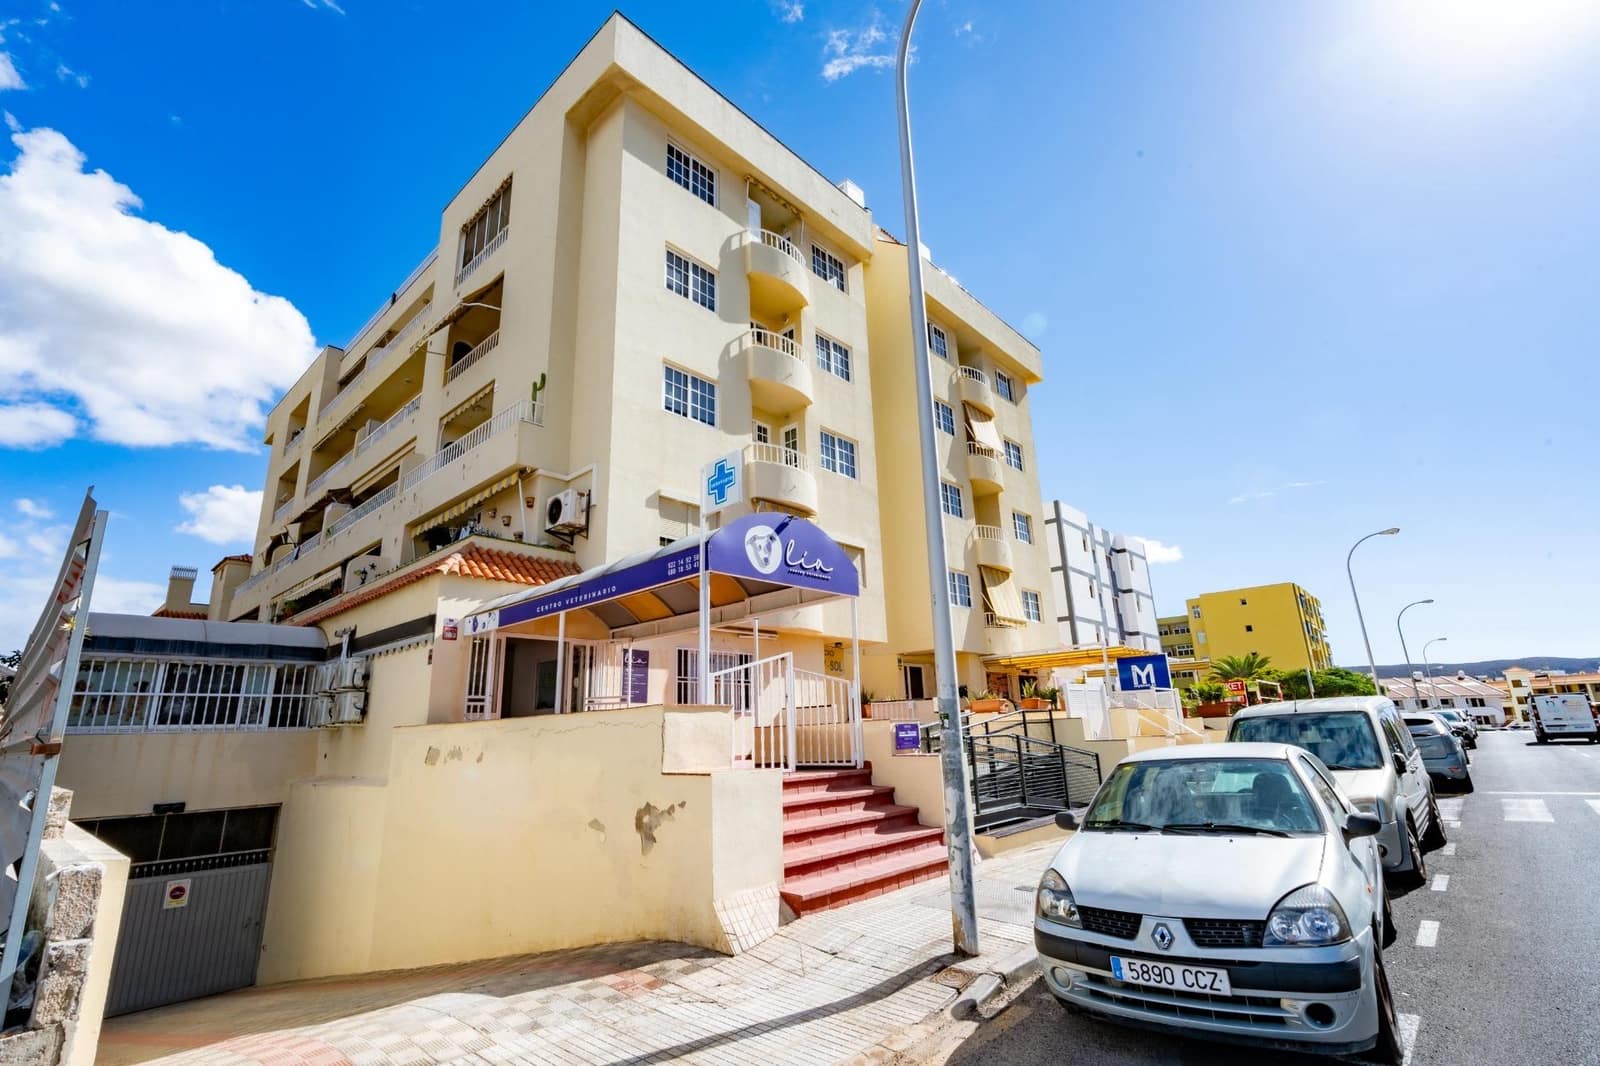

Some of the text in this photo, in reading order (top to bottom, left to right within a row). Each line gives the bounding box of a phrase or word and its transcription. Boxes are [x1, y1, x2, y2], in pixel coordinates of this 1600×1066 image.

[536, 586, 617, 613] CENTRO VETERINARIO
[1131, 663, 1155, 687] M
[1128, 961, 1175, 986] 5890
[1182, 968, 1222, 992] CCZ
